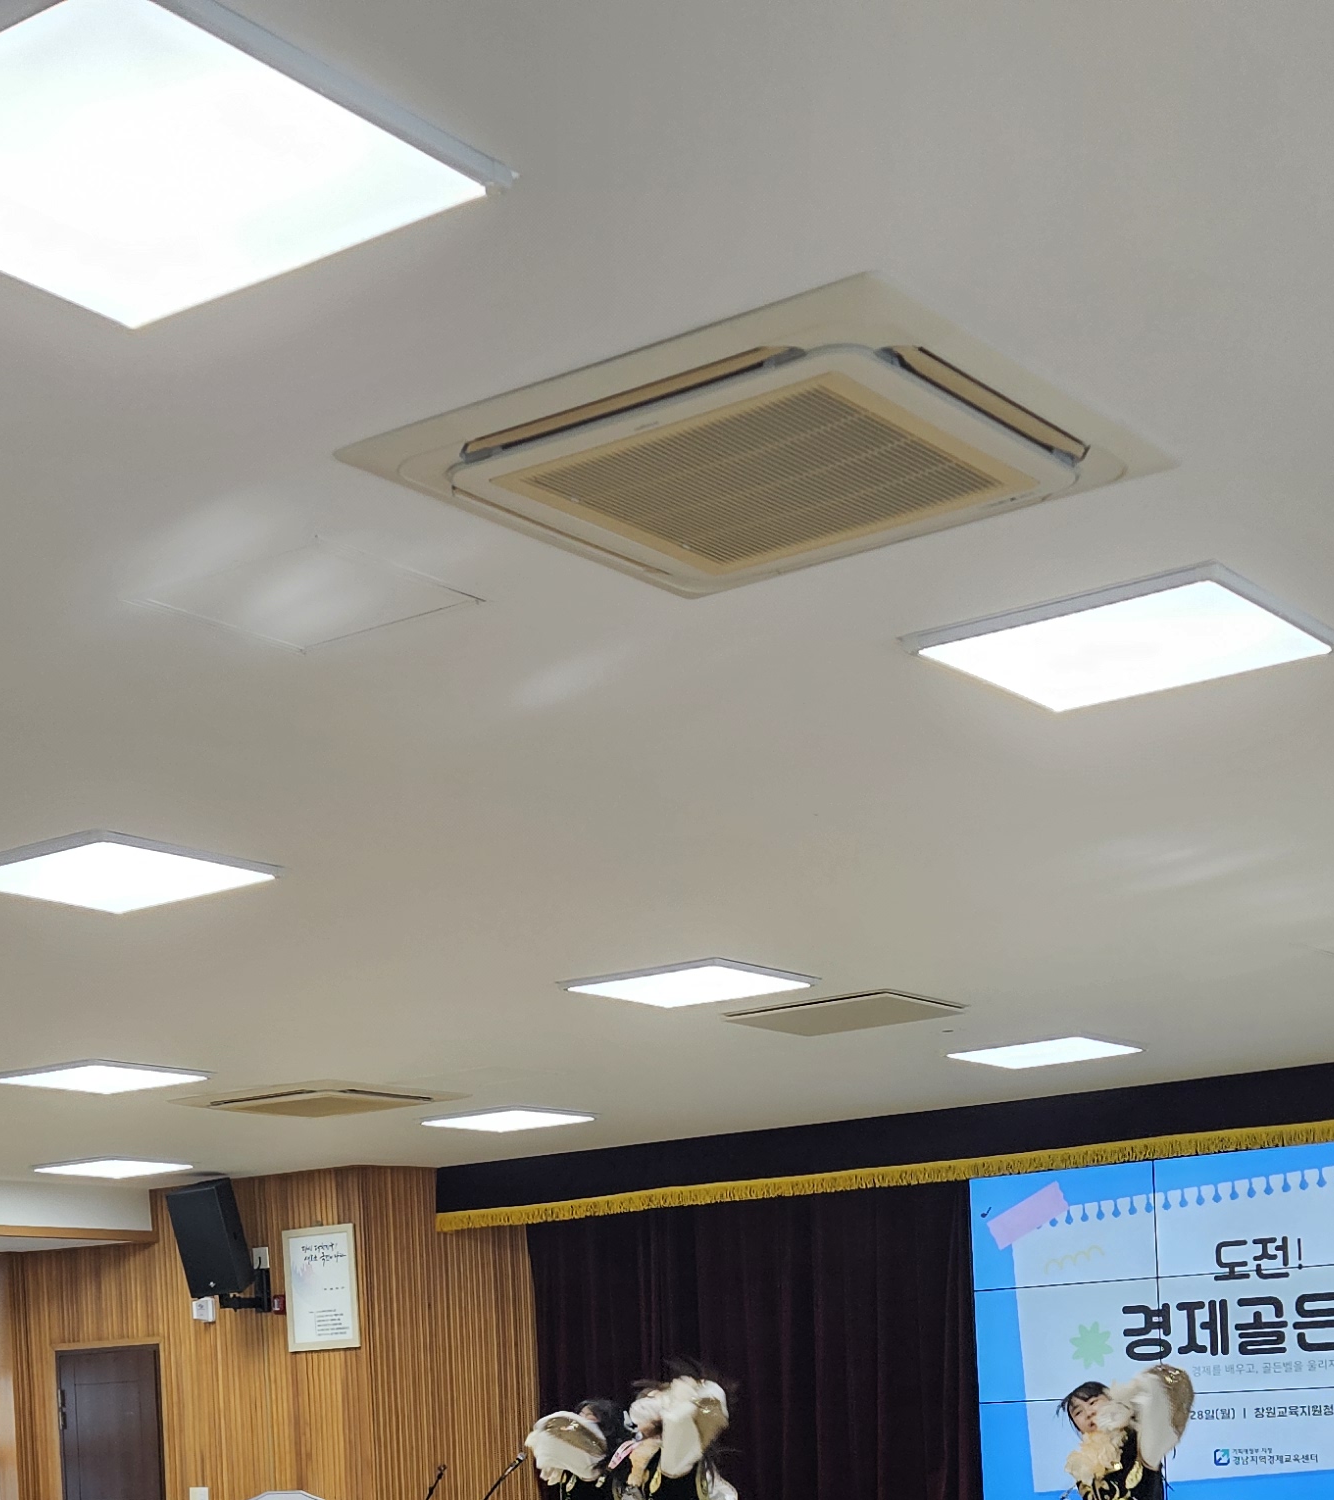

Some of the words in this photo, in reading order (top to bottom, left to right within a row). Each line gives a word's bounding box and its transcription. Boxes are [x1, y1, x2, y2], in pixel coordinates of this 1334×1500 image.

[1213, 1234, 1305, 1283] 도전!
[1191, 1364, 1221, 1377] 경제를
[1261, 1361, 1304, 1375] 골든벨을
[1253, 1403, 1334, 1419] 창원교육지원청
[1233, 1453, 1319, 1466] 경남지역경제교육센터
